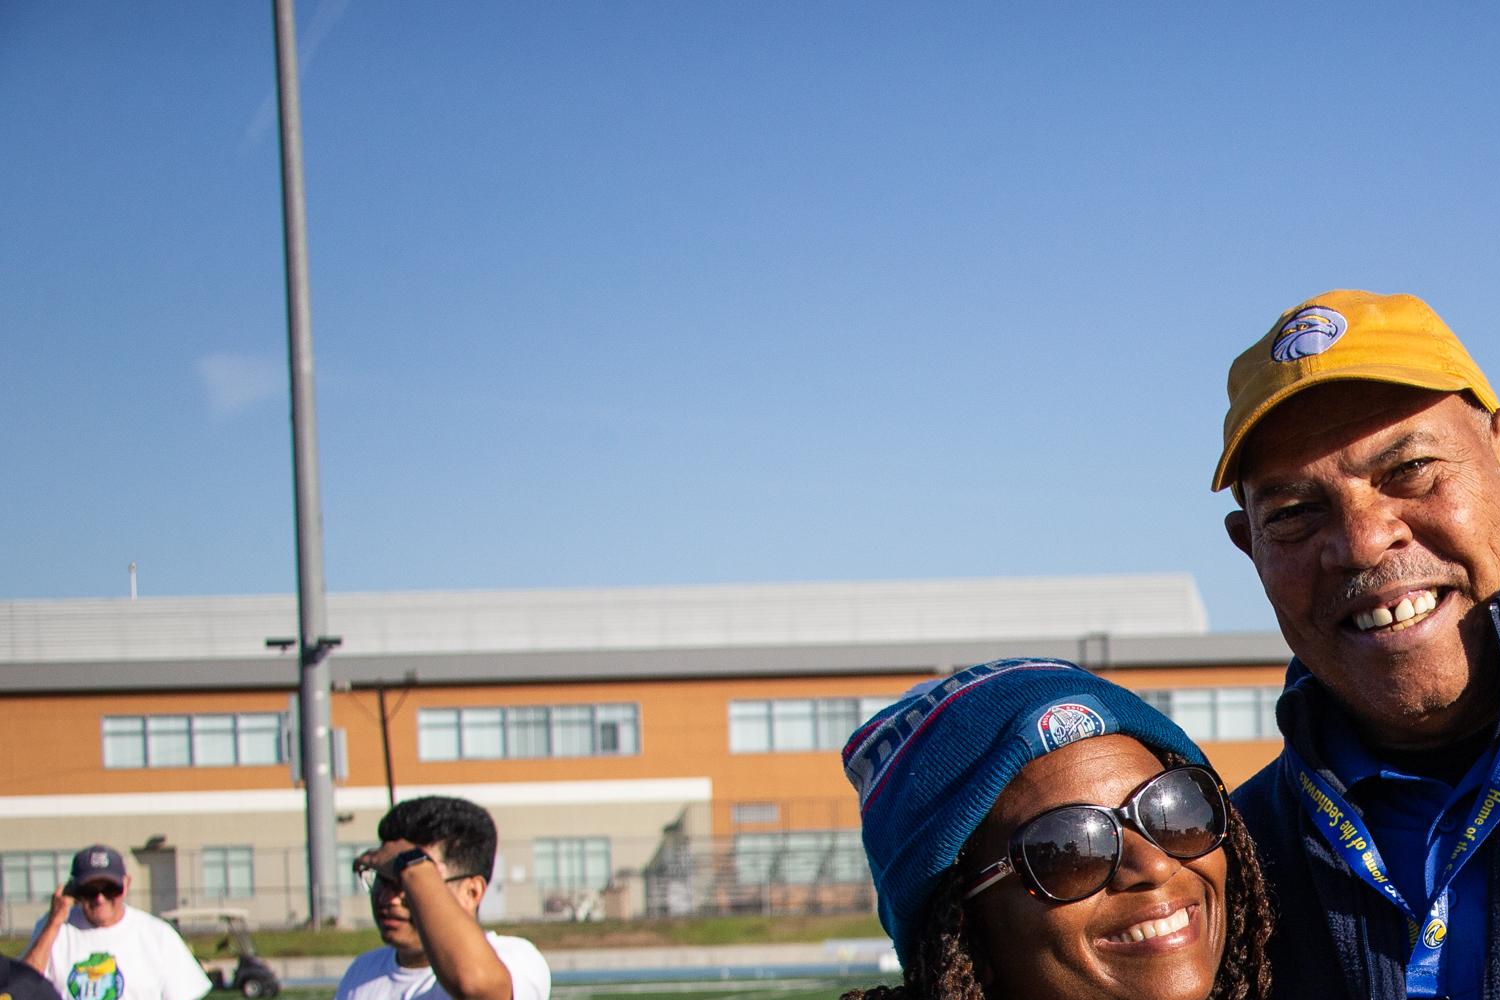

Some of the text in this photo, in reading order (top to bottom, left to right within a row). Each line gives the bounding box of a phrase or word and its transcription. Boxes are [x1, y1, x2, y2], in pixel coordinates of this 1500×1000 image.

[1300, 769, 1389, 884] Home of the Seahawks
[1465, 826, 1476, 841] of
